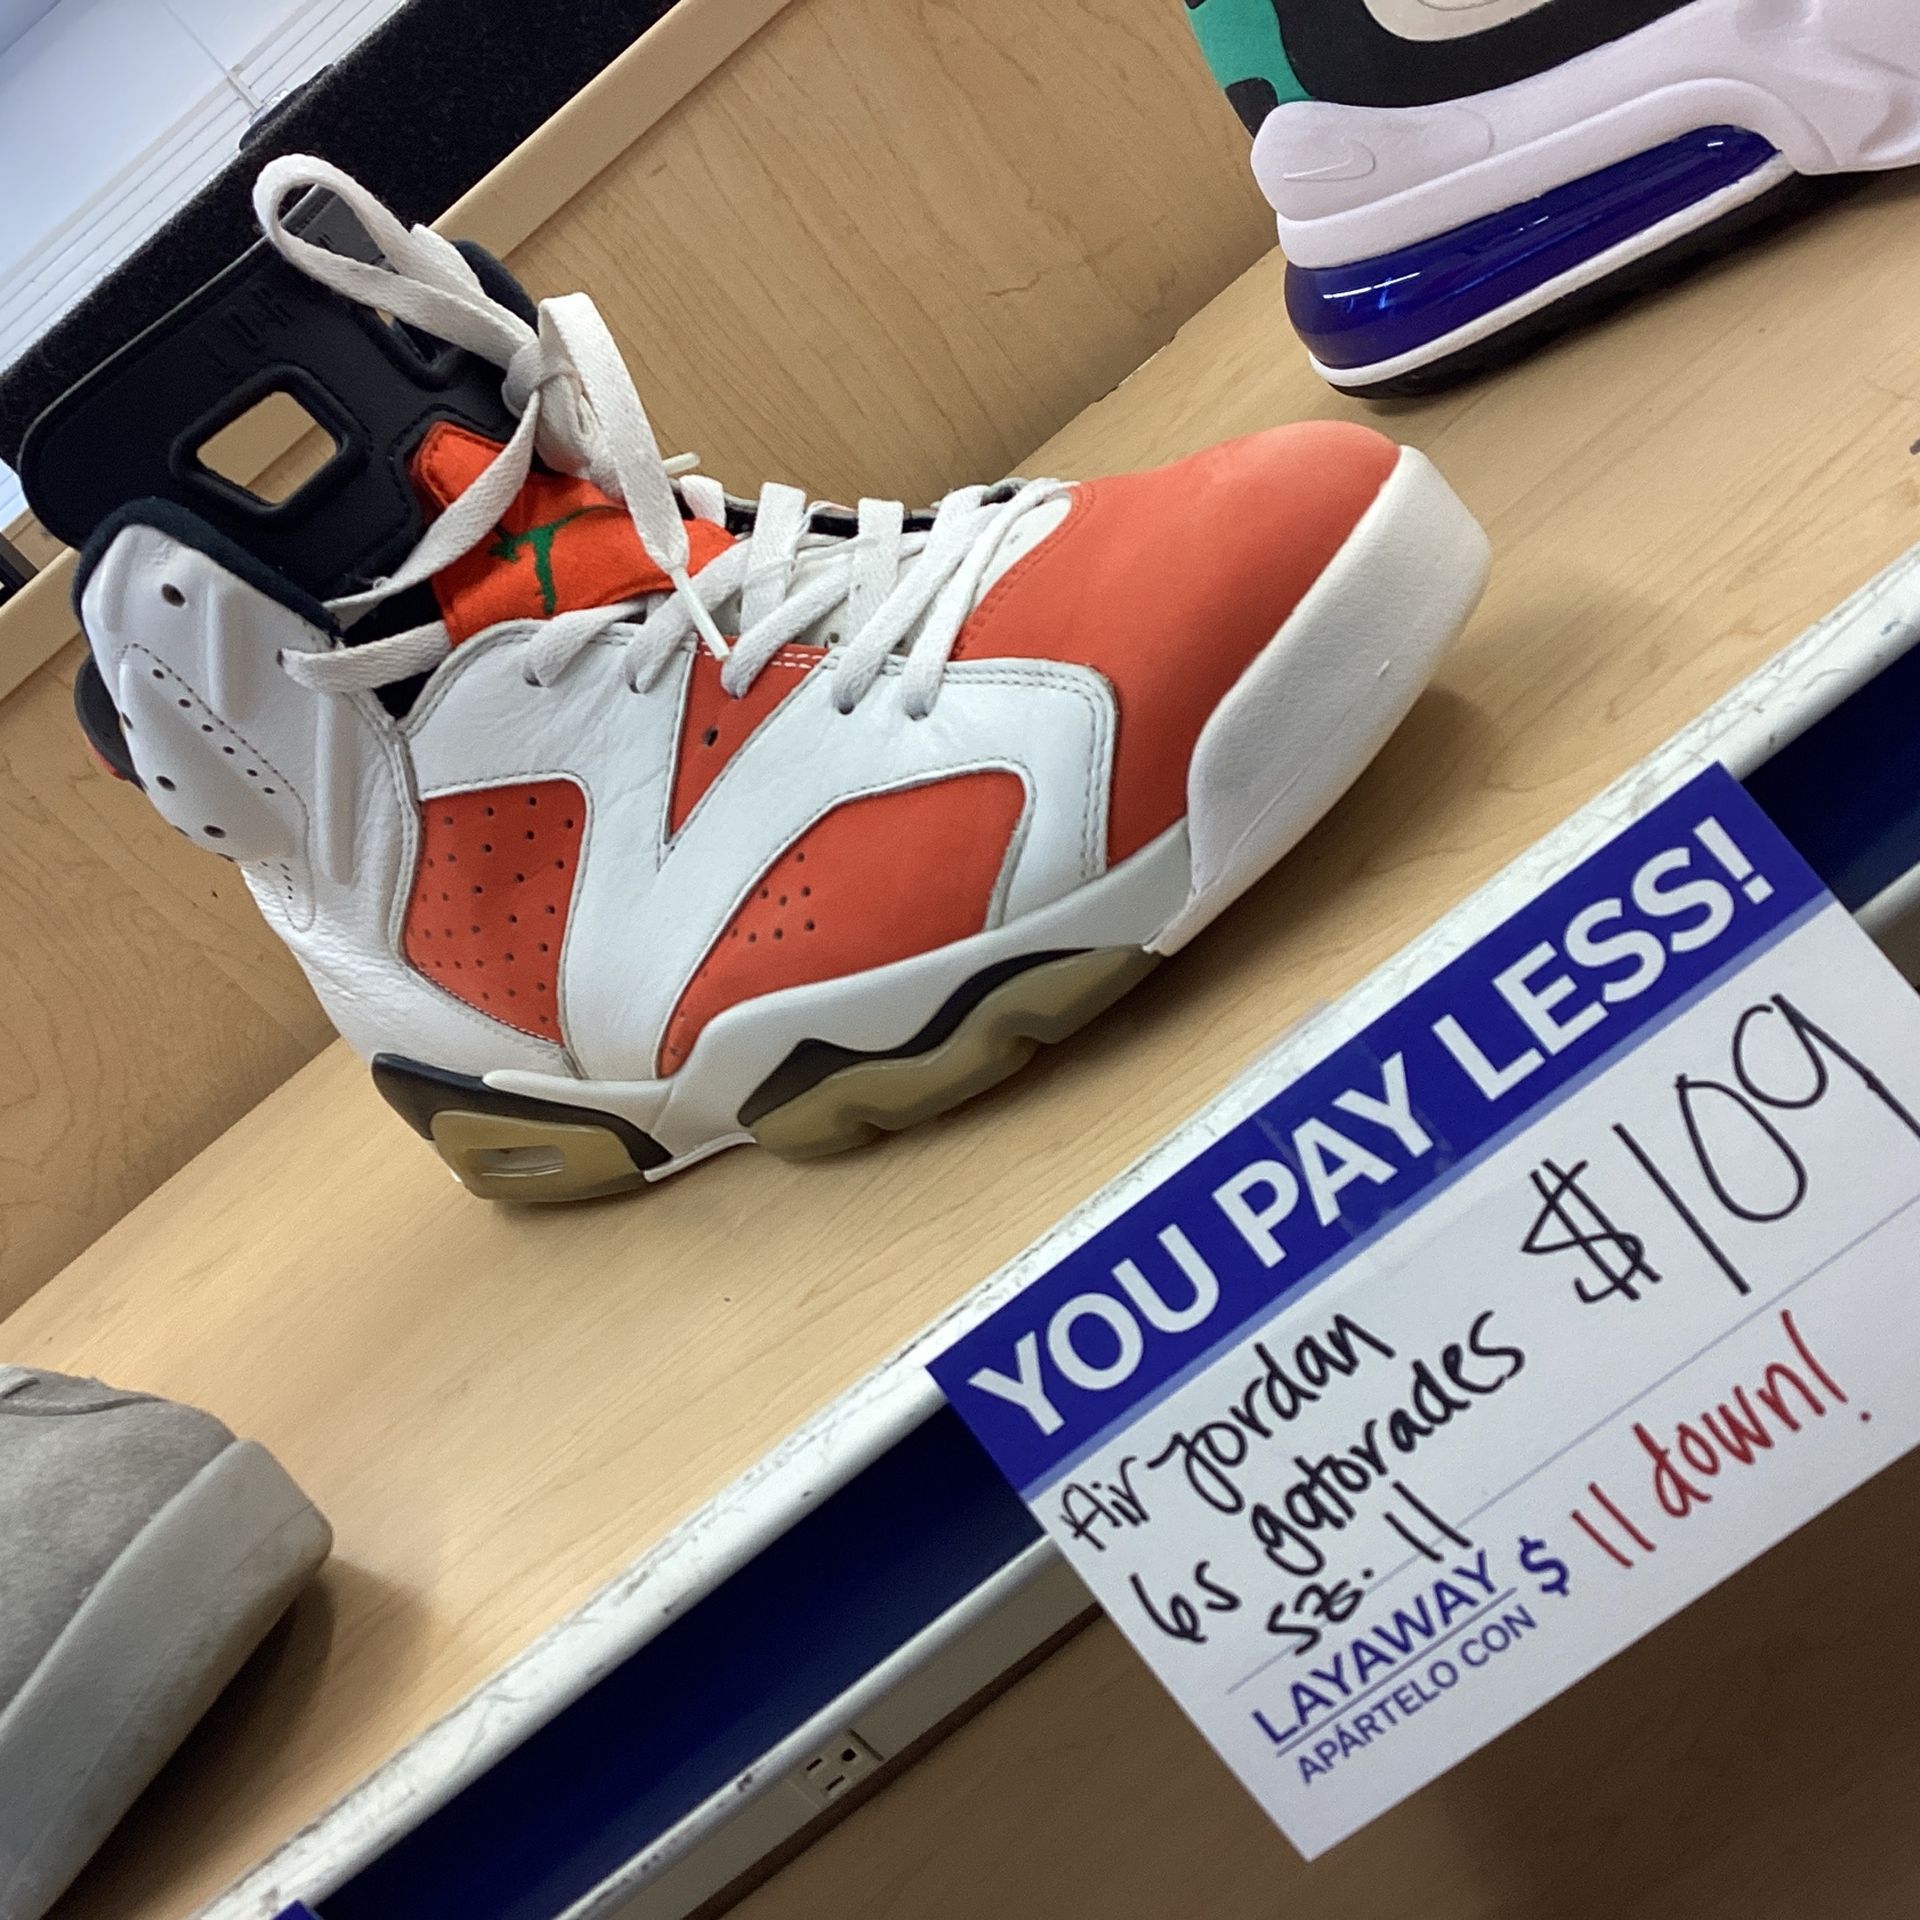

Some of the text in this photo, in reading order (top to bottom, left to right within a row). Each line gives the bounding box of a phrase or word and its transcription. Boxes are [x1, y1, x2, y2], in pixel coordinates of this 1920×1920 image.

[968, 816, 1775, 1436] YOU PAY LESS!
[1521, 993, 1920, 1304] $109
[1060, 1313, 1396, 1551] Air Jordan
[1130, 1310, 1526, 1645] 6s gatorades
[1252, 1548, 1497, 1745] LAYAWAY
[1632, 1309, 1872, 1518] down!
[1383, 1480, 1473, 1563] 11
[1296, 1602, 1537, 1786] APÁRTELO CON
